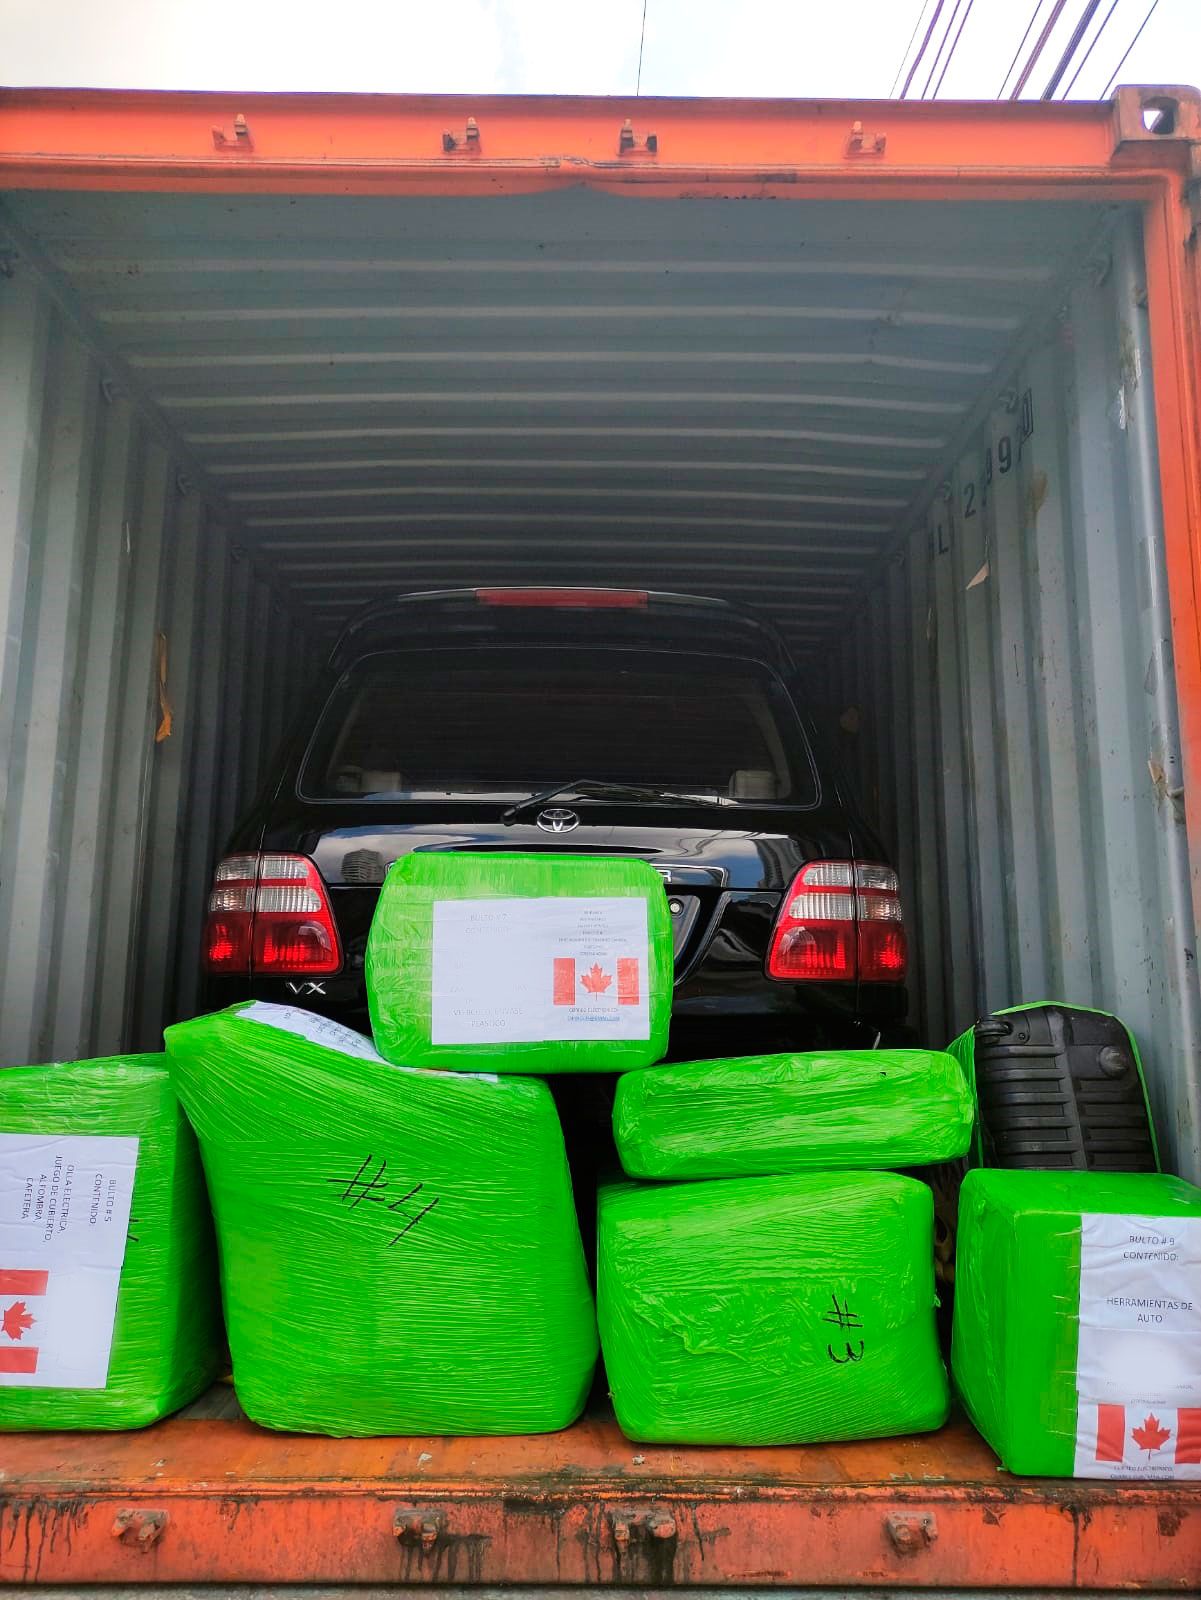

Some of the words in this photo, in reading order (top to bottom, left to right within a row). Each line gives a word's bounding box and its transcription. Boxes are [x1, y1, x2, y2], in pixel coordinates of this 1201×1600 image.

[285, 981, 327, 995] VX
[52, 1155, 63, 1183] JUEGO
[65, 1165, 75, 1186] OLLA
[50, 1185, 59, 1196] DE
[106, 1179, 117, 1207] BULTO
[21, 1177, 33, 1219] CAFETERA
[42, 1198, 57, 1244] CUBIERTO,
[1129, 1235, 1159, 1245] BULTO
[1123, 1251, 1179, 1261] CONTENIDO:
[1107, 1297, 1179, 1310] HERRAMIENTAS
[1180, 1302, 1193, 1311] DE
[1137, 1313, 1163, 1323] AUTO
